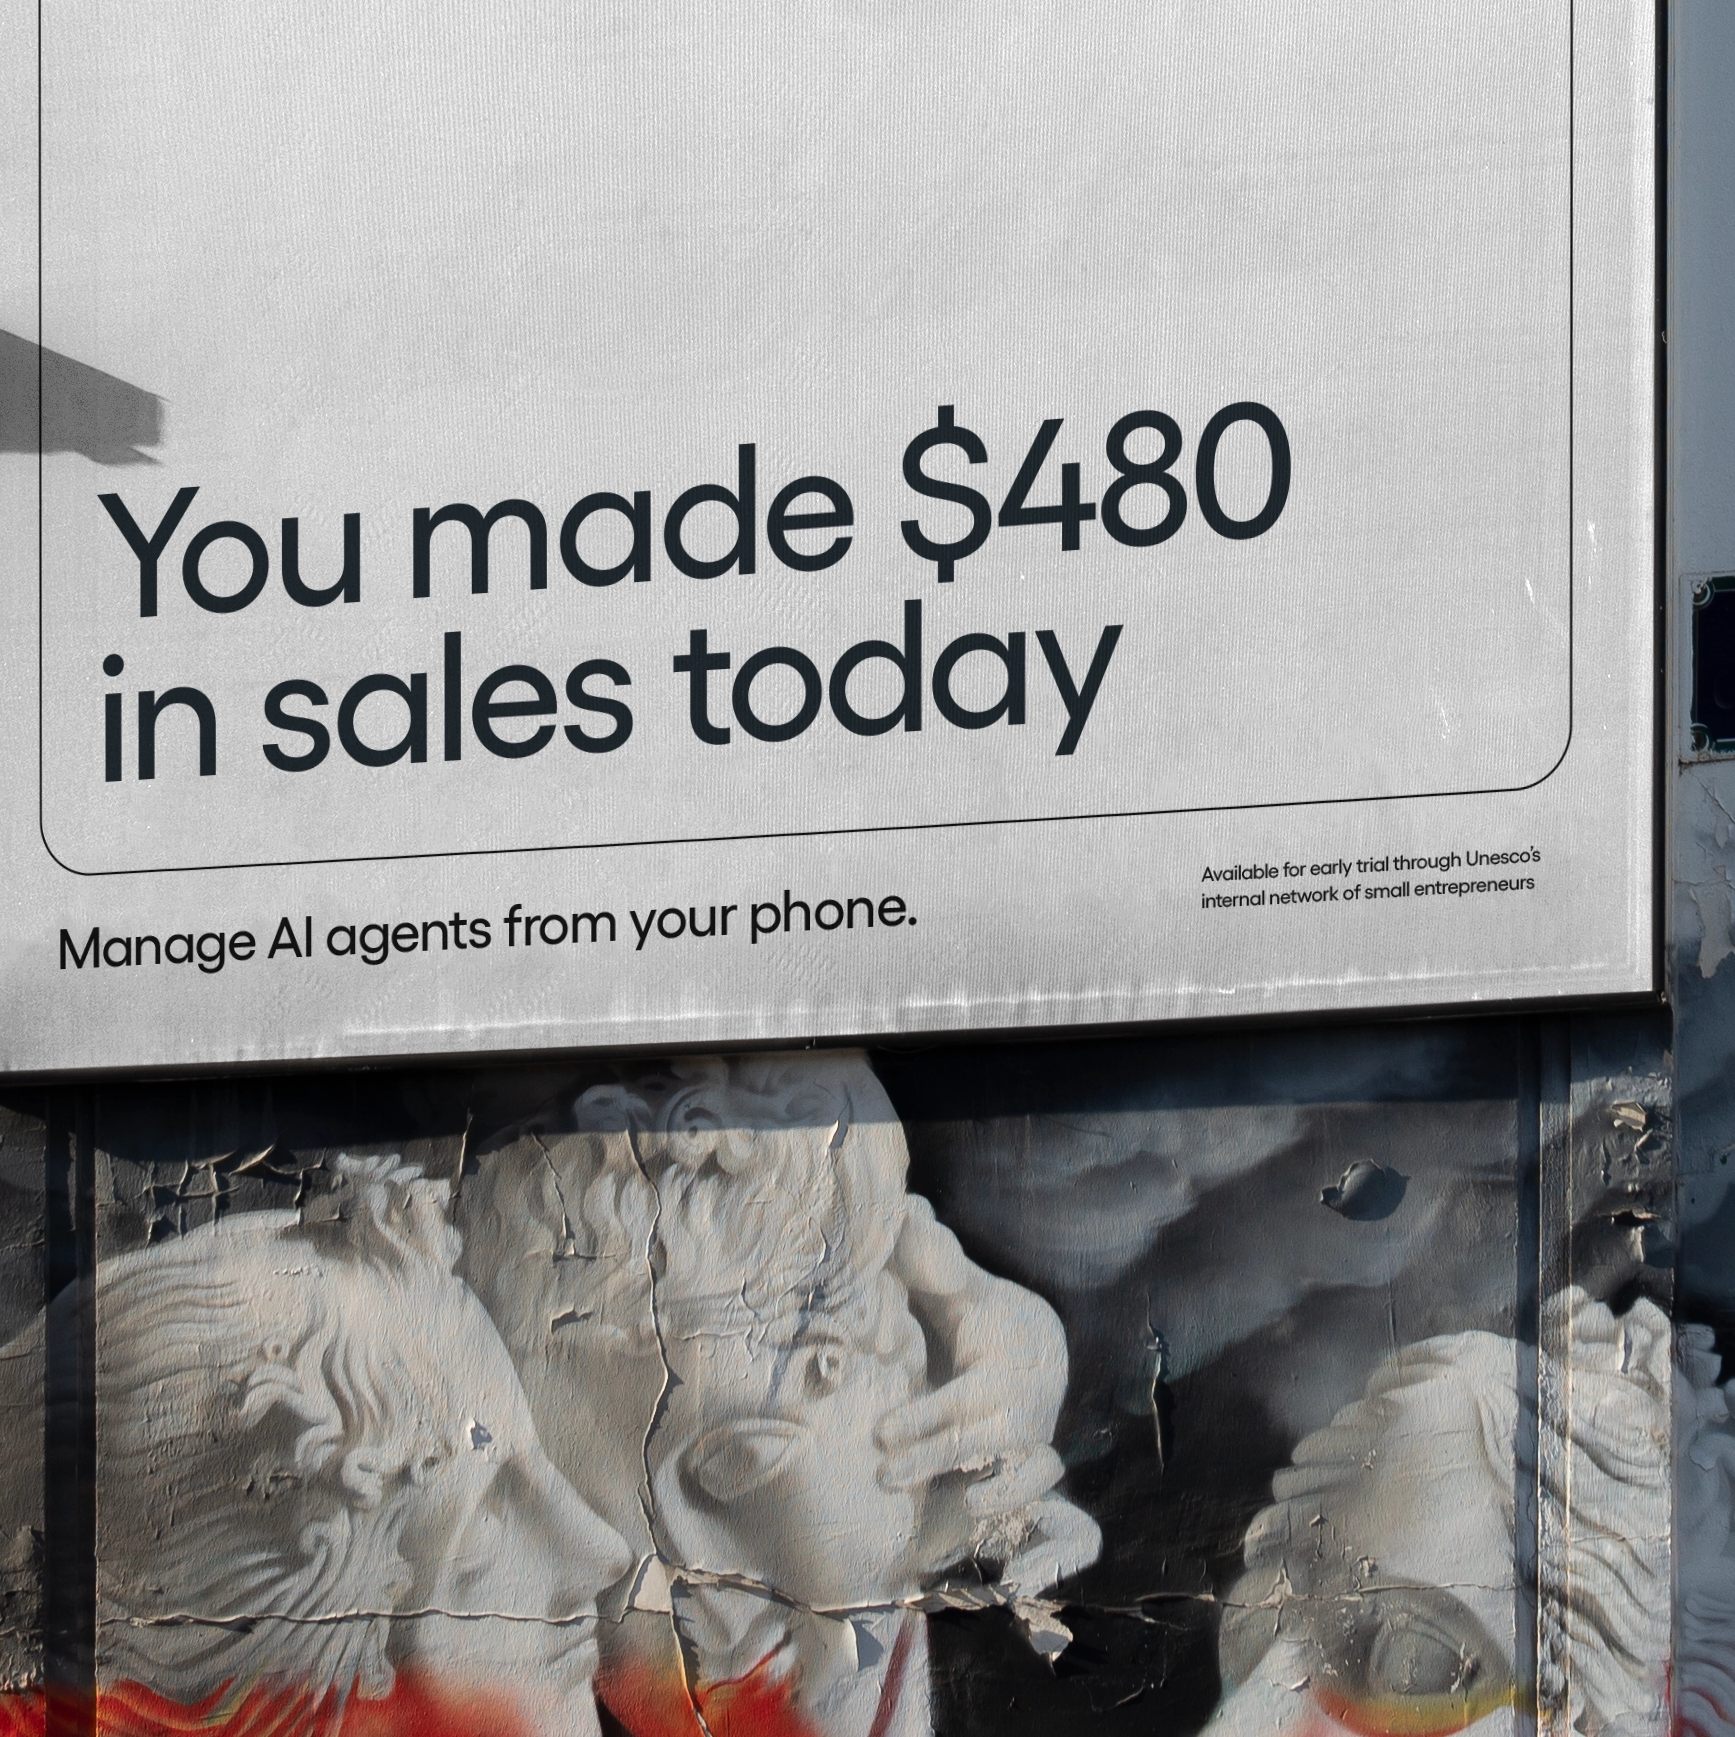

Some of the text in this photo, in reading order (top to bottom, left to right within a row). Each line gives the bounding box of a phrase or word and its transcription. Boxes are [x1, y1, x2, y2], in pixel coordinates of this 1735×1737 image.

[95, 400, 1293, 619] You made $480
[101, 597, 1125, 784] in sales today
[1201, 862, 1279, 883] Available
[1283, 861, 1306, 878] for
[1310, 858, 1352, 878] early
[1356, 855, 1390, 874] trial
[1393, 851, 1462, 872] through
[1201, 875, 1536, 909] internal network of small entrepreneurs
[58, 888, 919, 976] Manage AI agents from your phone.
